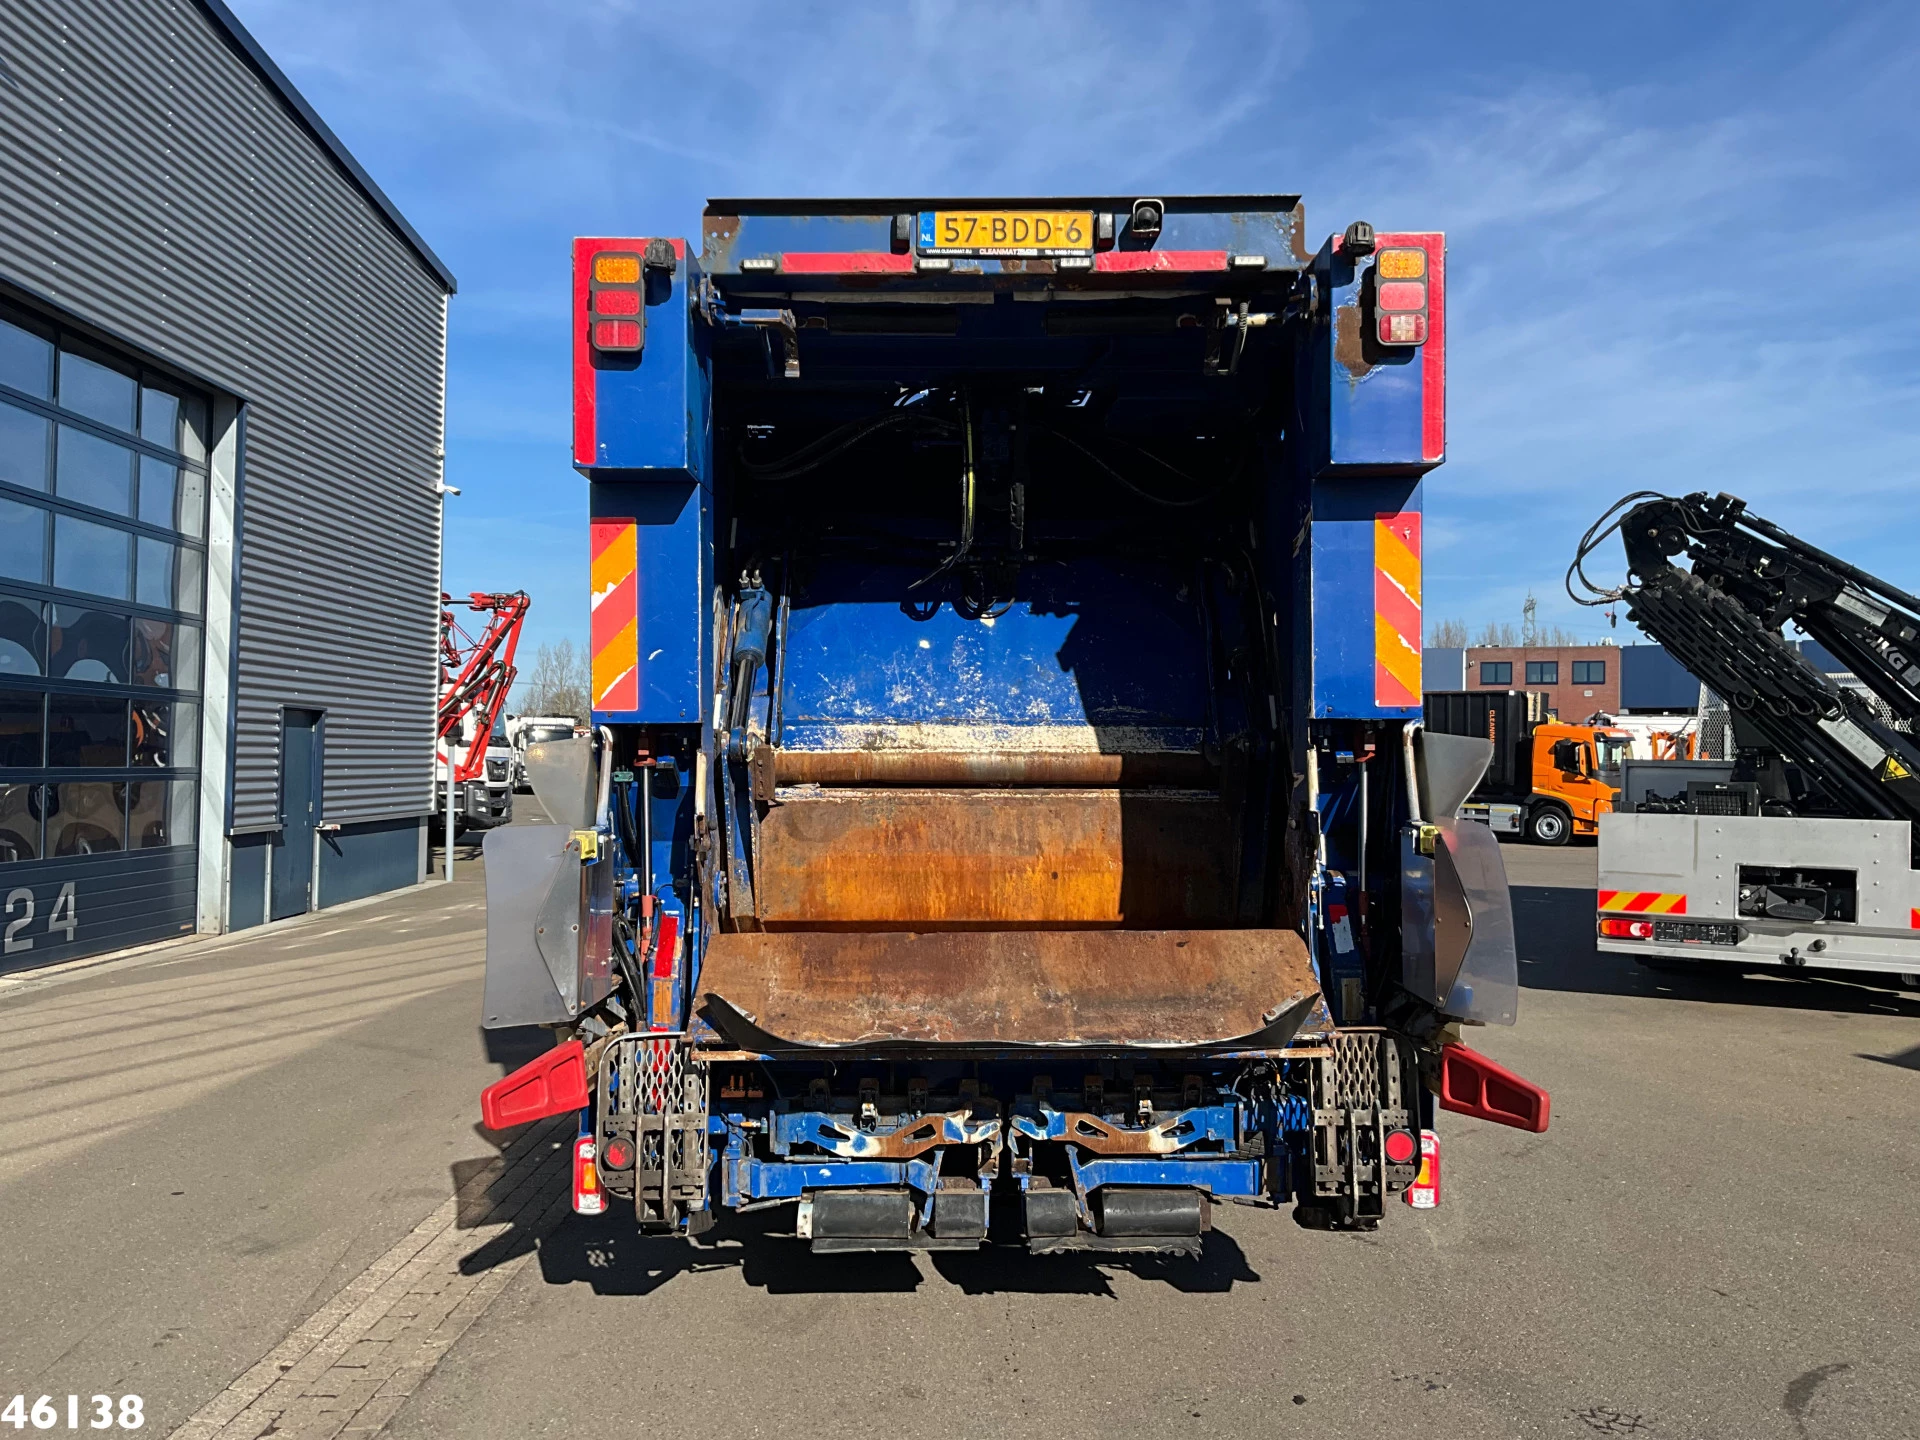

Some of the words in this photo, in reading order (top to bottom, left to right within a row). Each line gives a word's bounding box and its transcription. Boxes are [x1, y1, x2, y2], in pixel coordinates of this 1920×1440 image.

[921, 233, 934, 242] NL
[944, 217, 1083, 244] 57-BDD-6
[4, 881, 78, 954] 24
